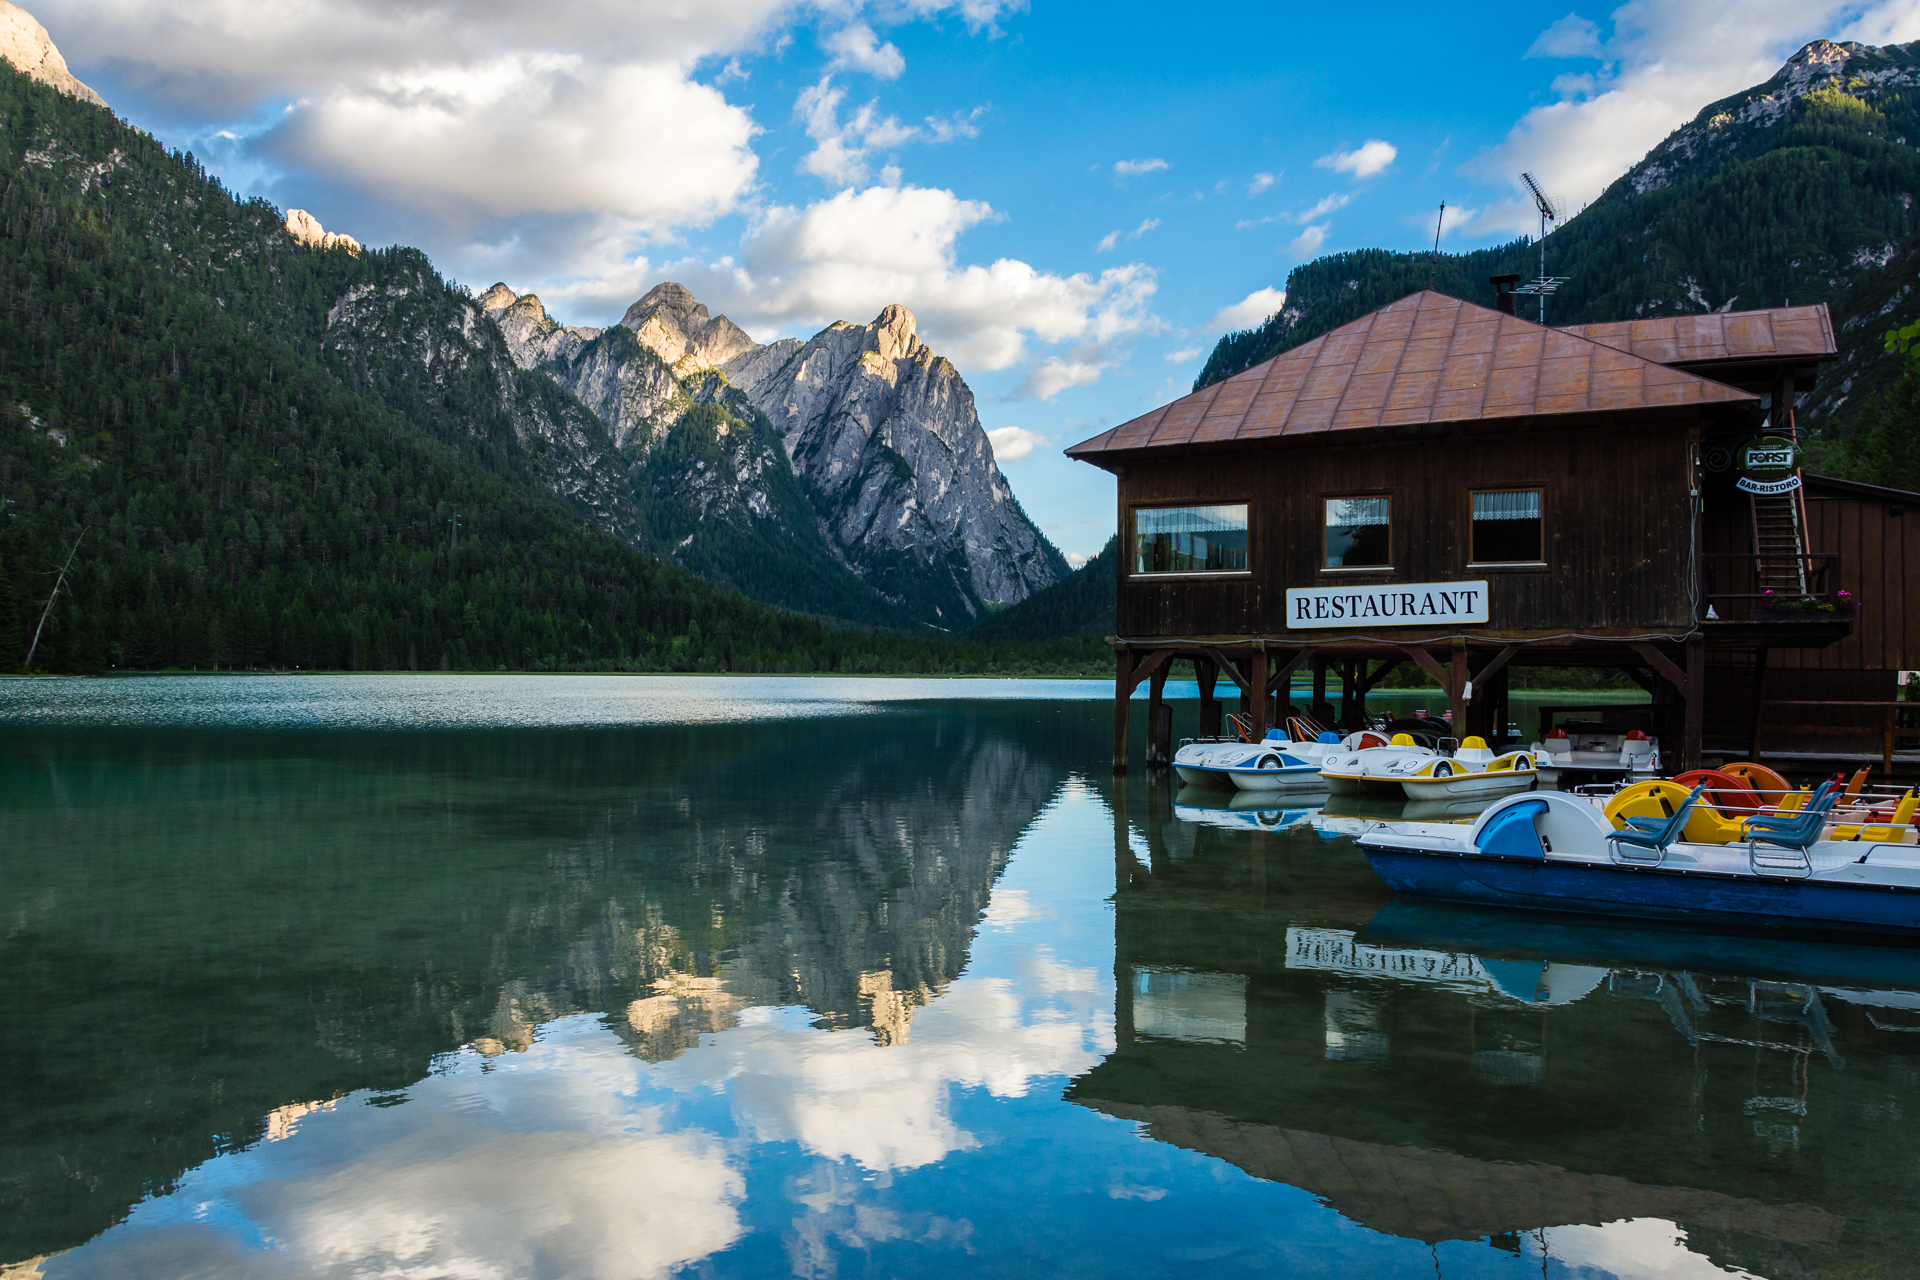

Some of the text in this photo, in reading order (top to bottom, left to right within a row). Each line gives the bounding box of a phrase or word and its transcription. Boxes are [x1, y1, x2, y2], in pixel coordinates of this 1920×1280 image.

[1749, 452, 1790, 463] FORST
[1739, 479, 1799, 492] BAR-RISTORO
[1295, 591, 1478, 619] RESTAURANT
